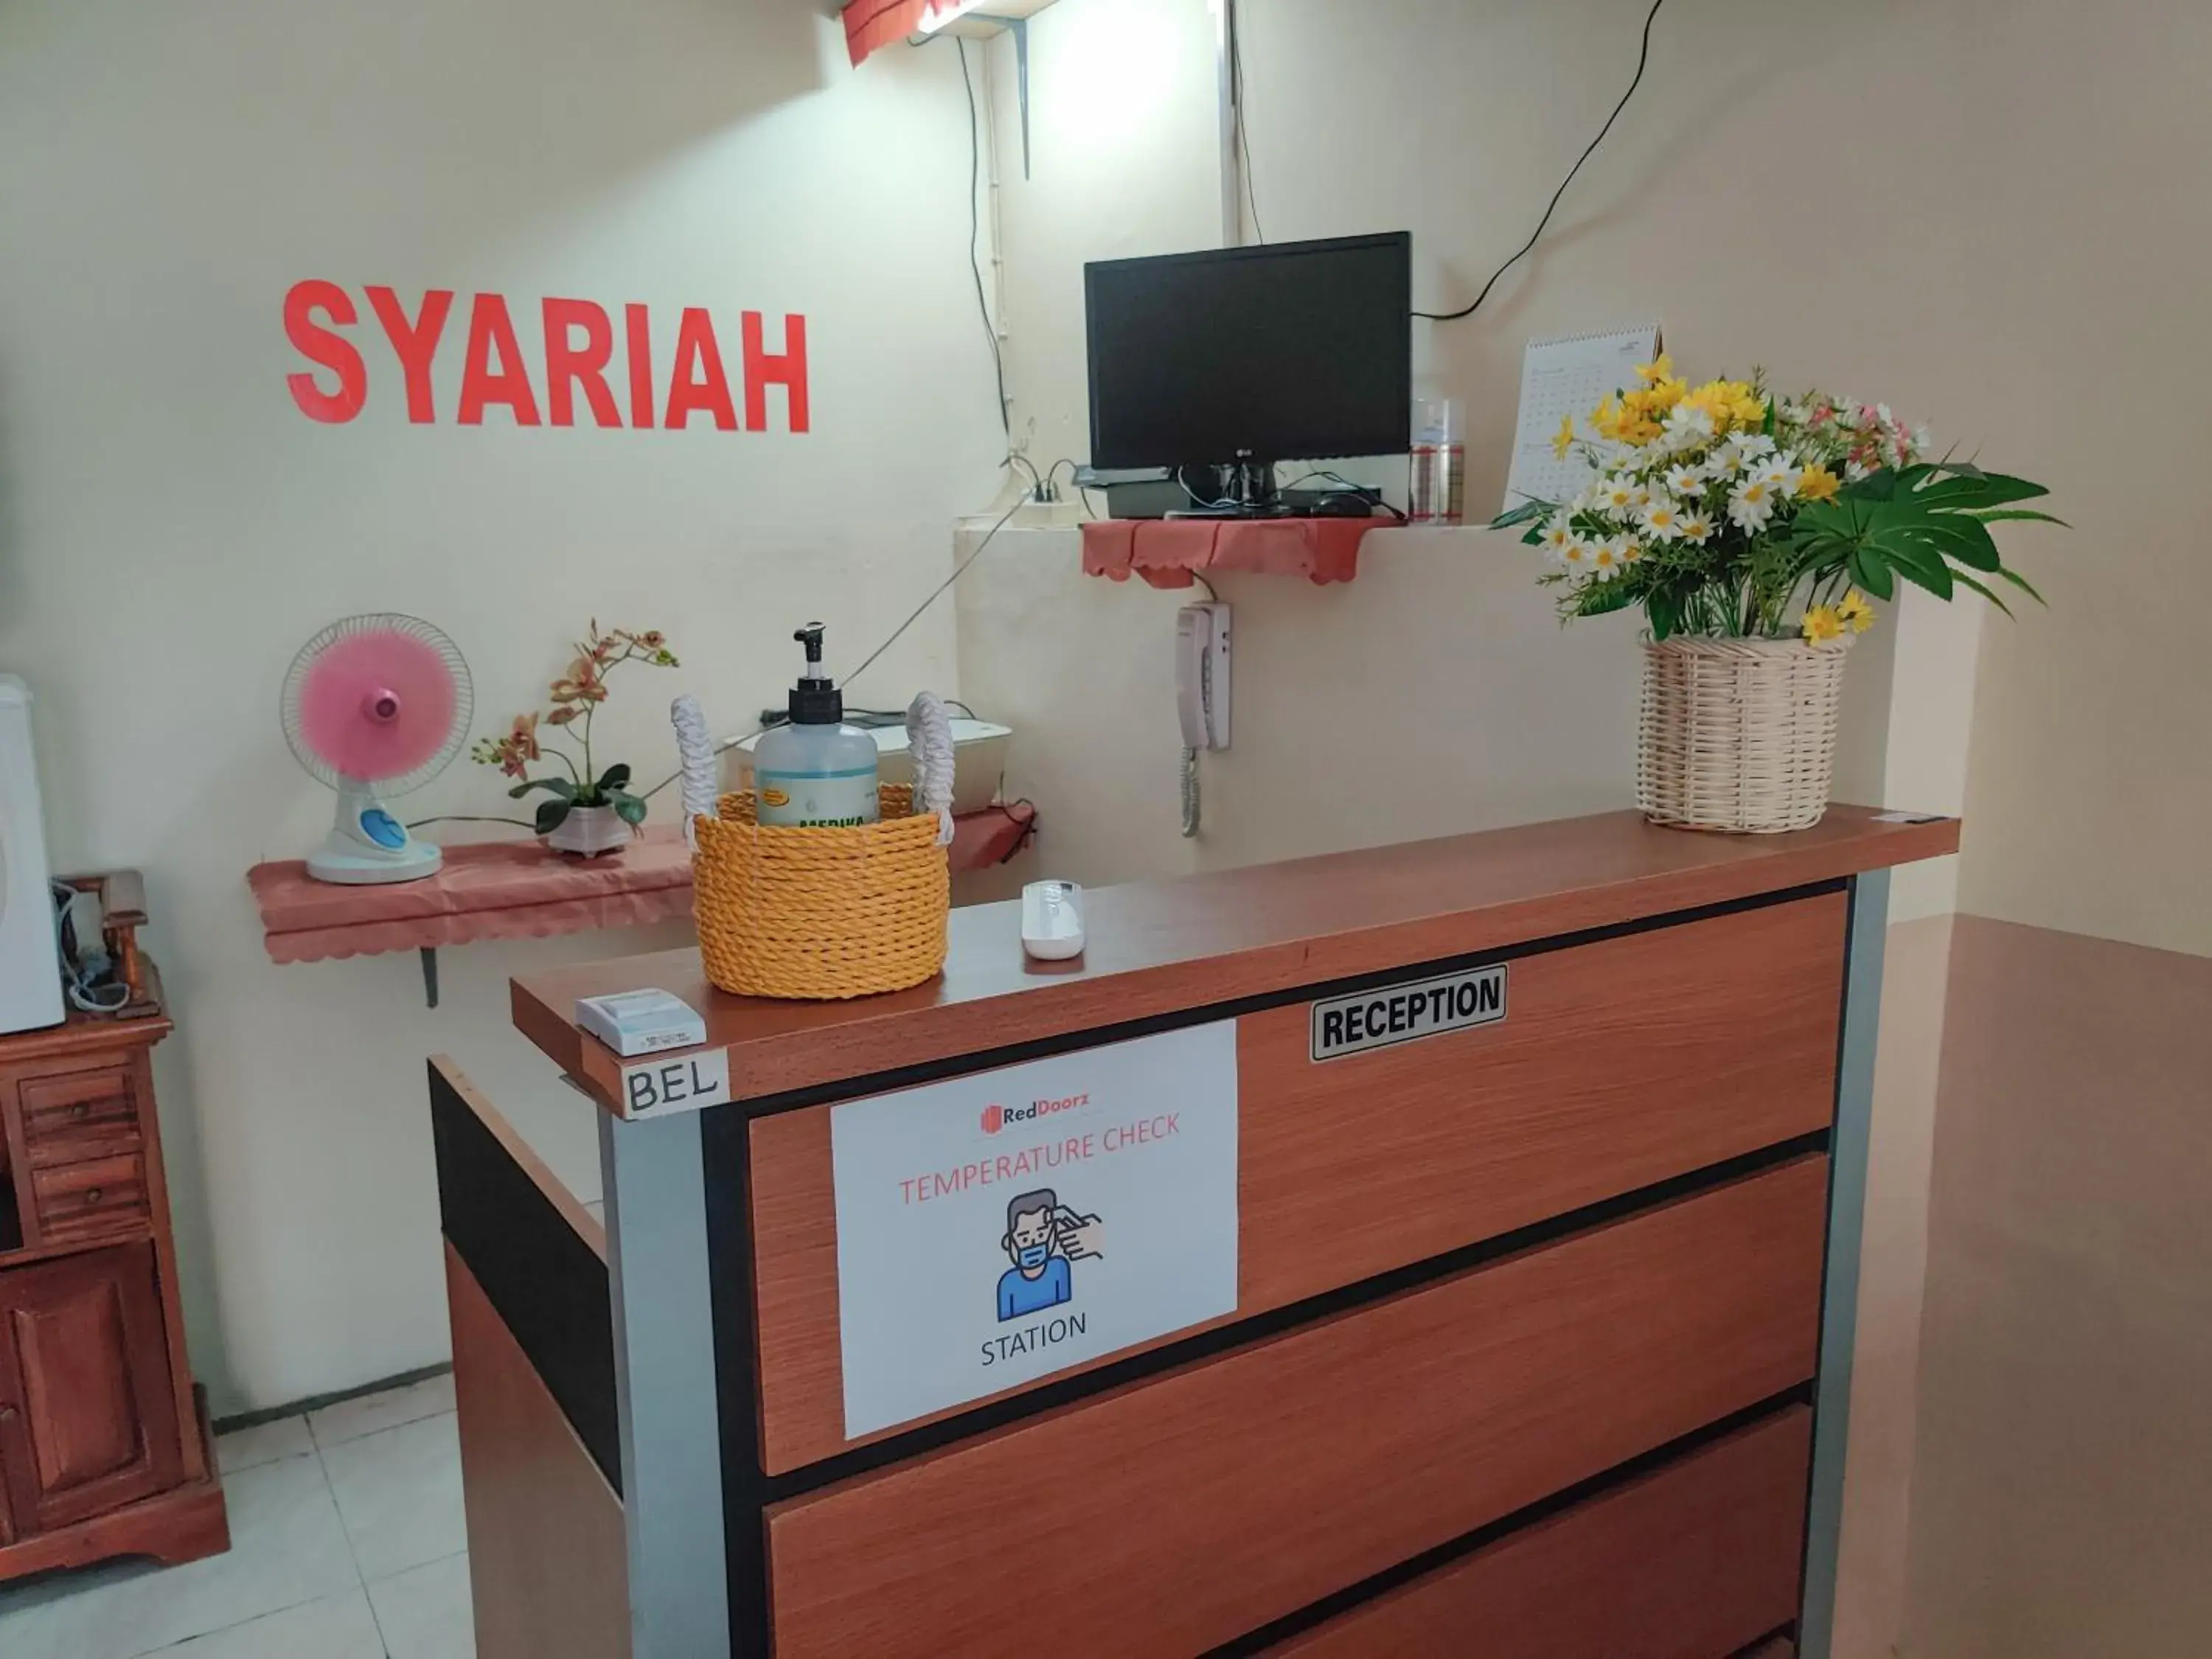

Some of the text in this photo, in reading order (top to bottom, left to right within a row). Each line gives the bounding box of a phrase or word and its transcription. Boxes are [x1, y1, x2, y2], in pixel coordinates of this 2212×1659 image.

[283, 279, 810, 434] SYARIAH
[1324, 975, 1500, 1048] RECEPTION
[628, 1061, 718, 1112] BEL
[1004, 1093, 1090, 1124] RedDoorz
[899, 1112, 1180, 1205] TEMPERATURE CHECK
[981, 1312, 1086, 1366] STATION
